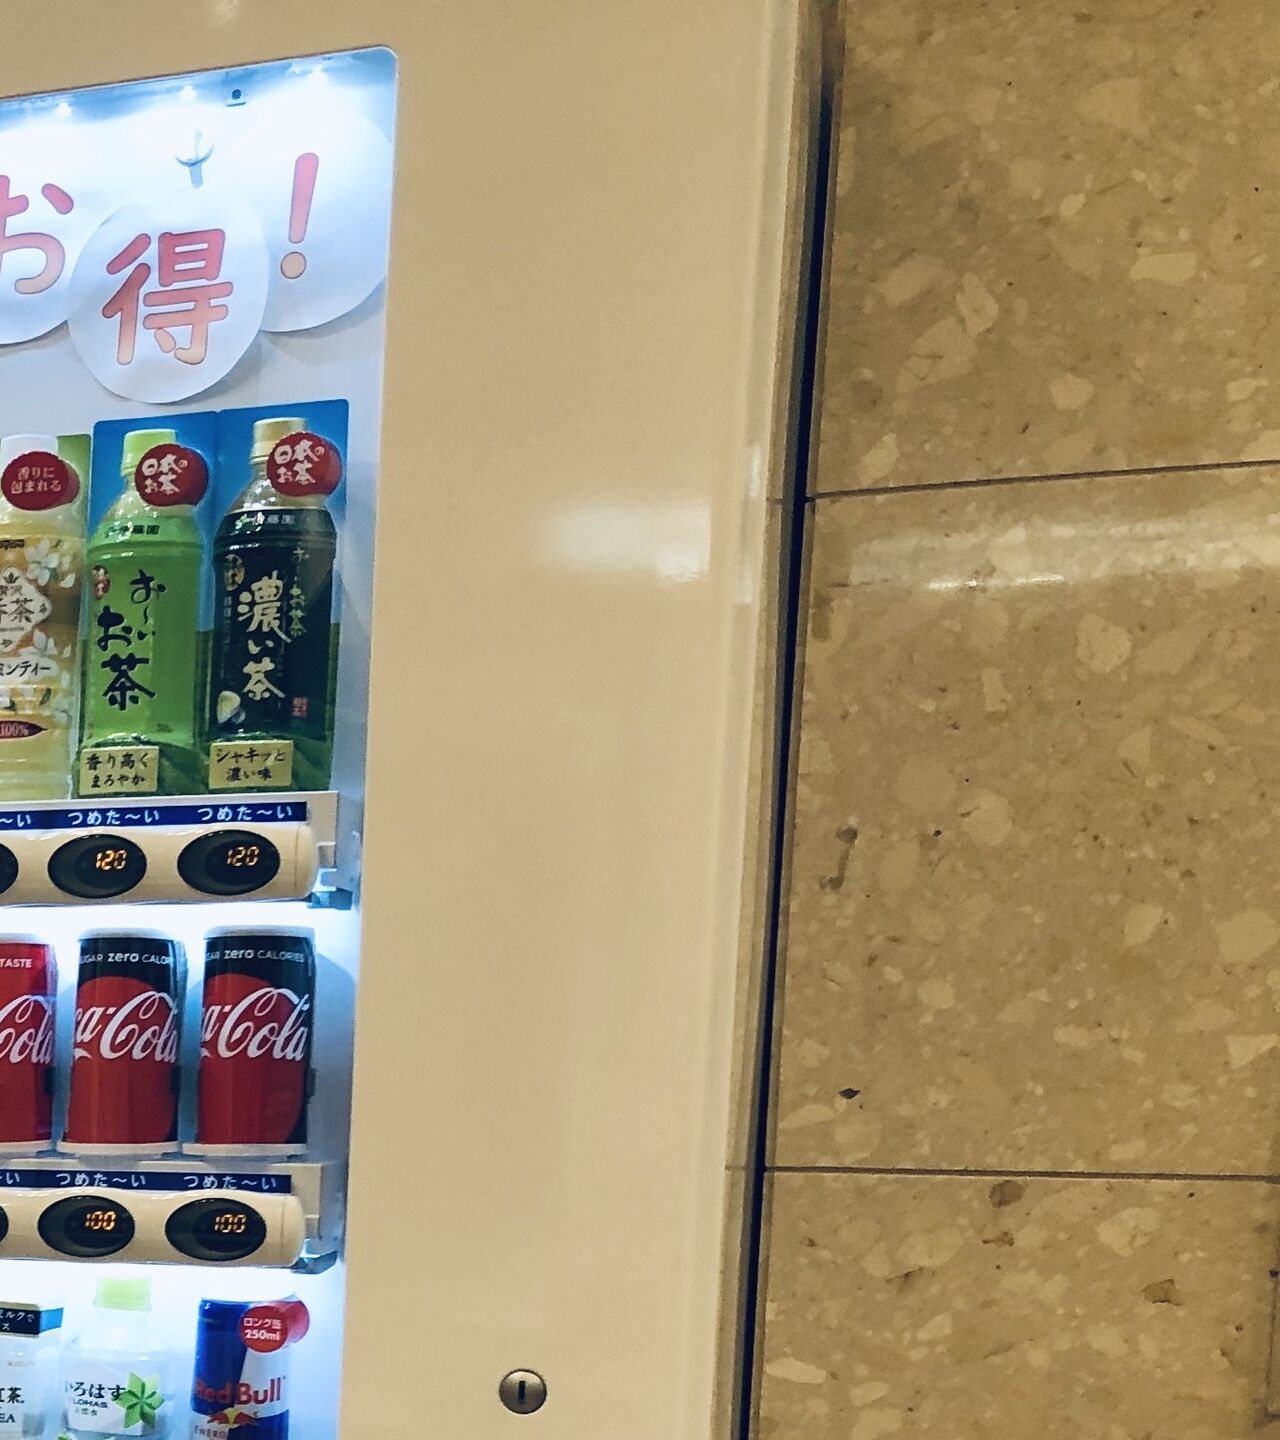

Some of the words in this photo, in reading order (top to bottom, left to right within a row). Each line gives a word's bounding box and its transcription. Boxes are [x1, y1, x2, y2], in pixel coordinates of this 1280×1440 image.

[274, 443, 325, 464] 日本の
[17, 465, 56, 480] 香りに
[142, 453, 189, 477] 日本の
[277, 463, 316, 485] お茶
[10, 480, 62, 494] 包まれる
[144, 472, 181, 495] お茶
[237, 571, 292, 701] 濃い茶
[97, 604, 156, 712] お茶
[86, 752, 150, 769] 香り高く
[215, 747, 287, 765] シャキッと
[89, 771, 146, 790] まろやか
[197, 806, 292, 821] つめた〜い
[0, 959, 32, 968] TASTE
[108, 953, 139, 962] zero
[224, 949, 253, 958] zero
[257, 951, 304, 963] CALORIES
[214, 1213, 246, 1233] 100
[243, 1317, 282, 1330] ロング缶
[243, 1329, 281, 1342] 250ml
[195, 1379, 231, 1402] Red
[237, 1377, 282, 1405] Bull
